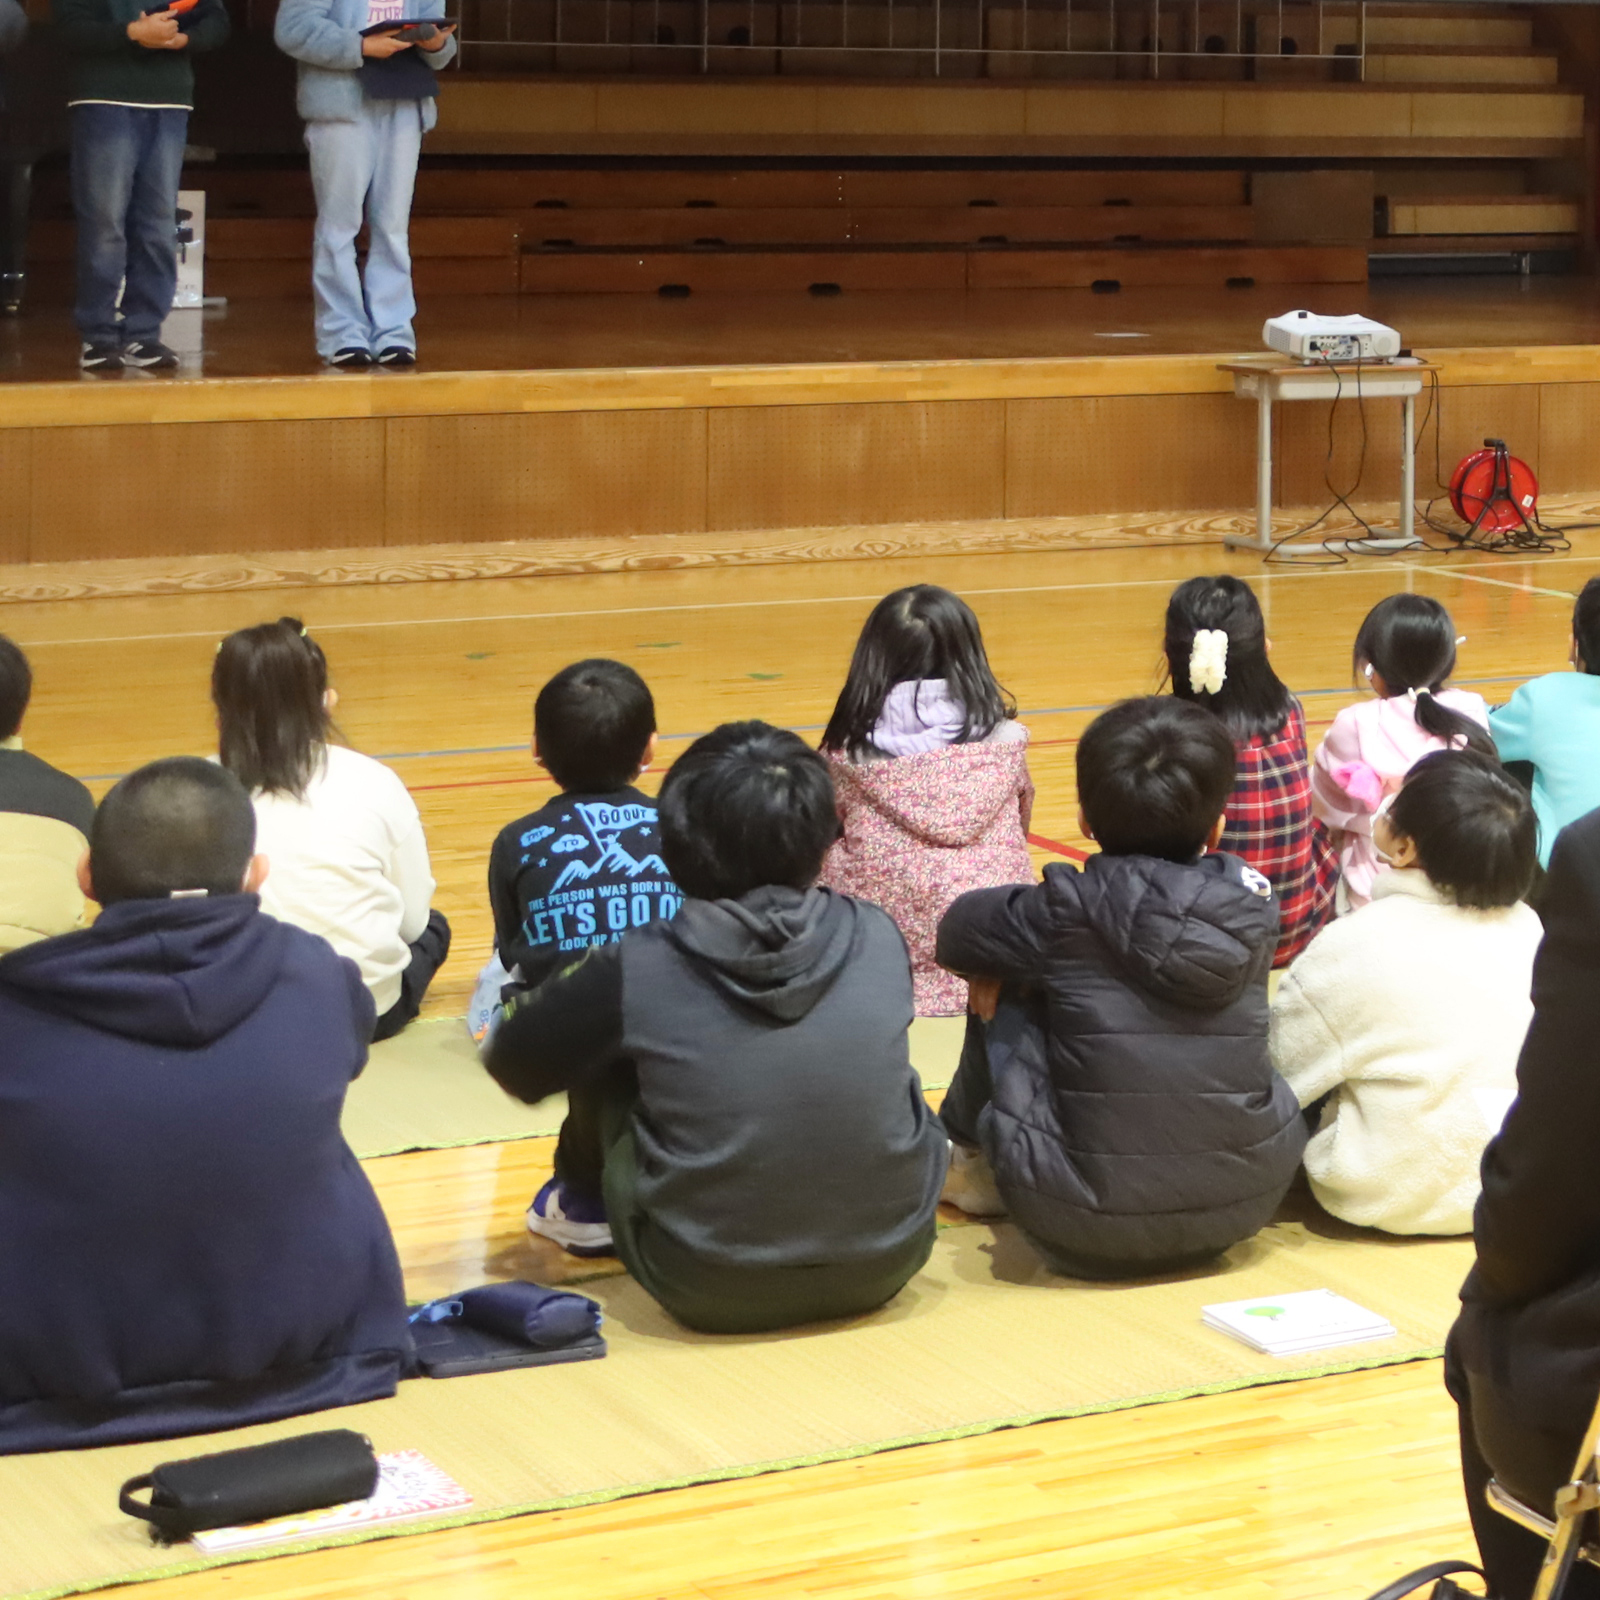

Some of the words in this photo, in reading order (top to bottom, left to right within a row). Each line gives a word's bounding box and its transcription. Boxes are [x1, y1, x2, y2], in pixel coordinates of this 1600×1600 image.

[600, 809, 620, 825] GO
[623, 808, 647, 821] OUT
[527, 829, 545, 841] TRY
[562, 839, 579, 847] TO
[528, 898, 545, 912] THE
[548, 888, 595, 906] PERSON
[598, 883, 628, 898] WAS
[631, 881, 661, 894] BORN
[664, 881, 676, 893] TO
[522, 902, 597, 946] LET'S
[608, 894, 650, 929] GO
[559, 937, 589, 951] LOOK
[592, 933, 608, 946] UP
